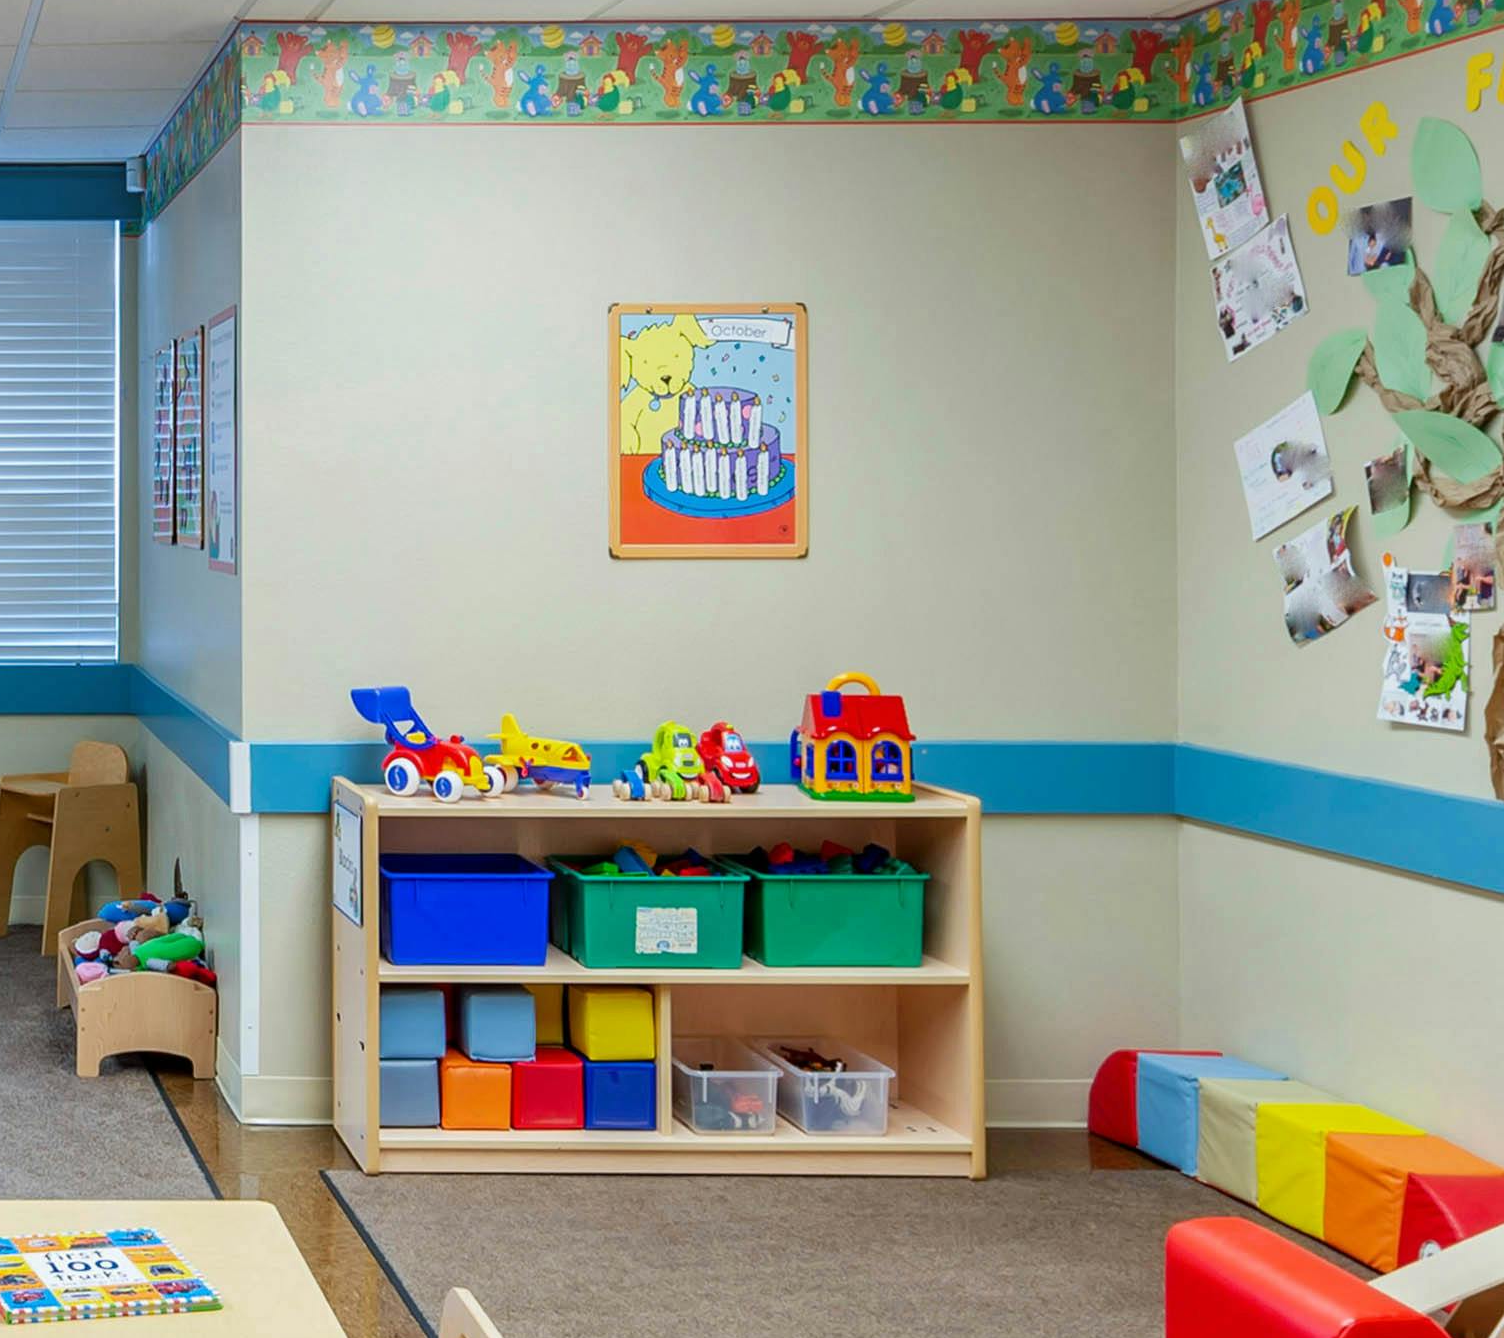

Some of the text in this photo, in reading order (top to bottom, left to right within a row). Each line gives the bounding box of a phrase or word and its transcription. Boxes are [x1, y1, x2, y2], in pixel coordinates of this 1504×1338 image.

[1307, 102, 1399, 235] OUR
[710, 324, 767, 339] October
[47, 1259, 119, 1273] 100
